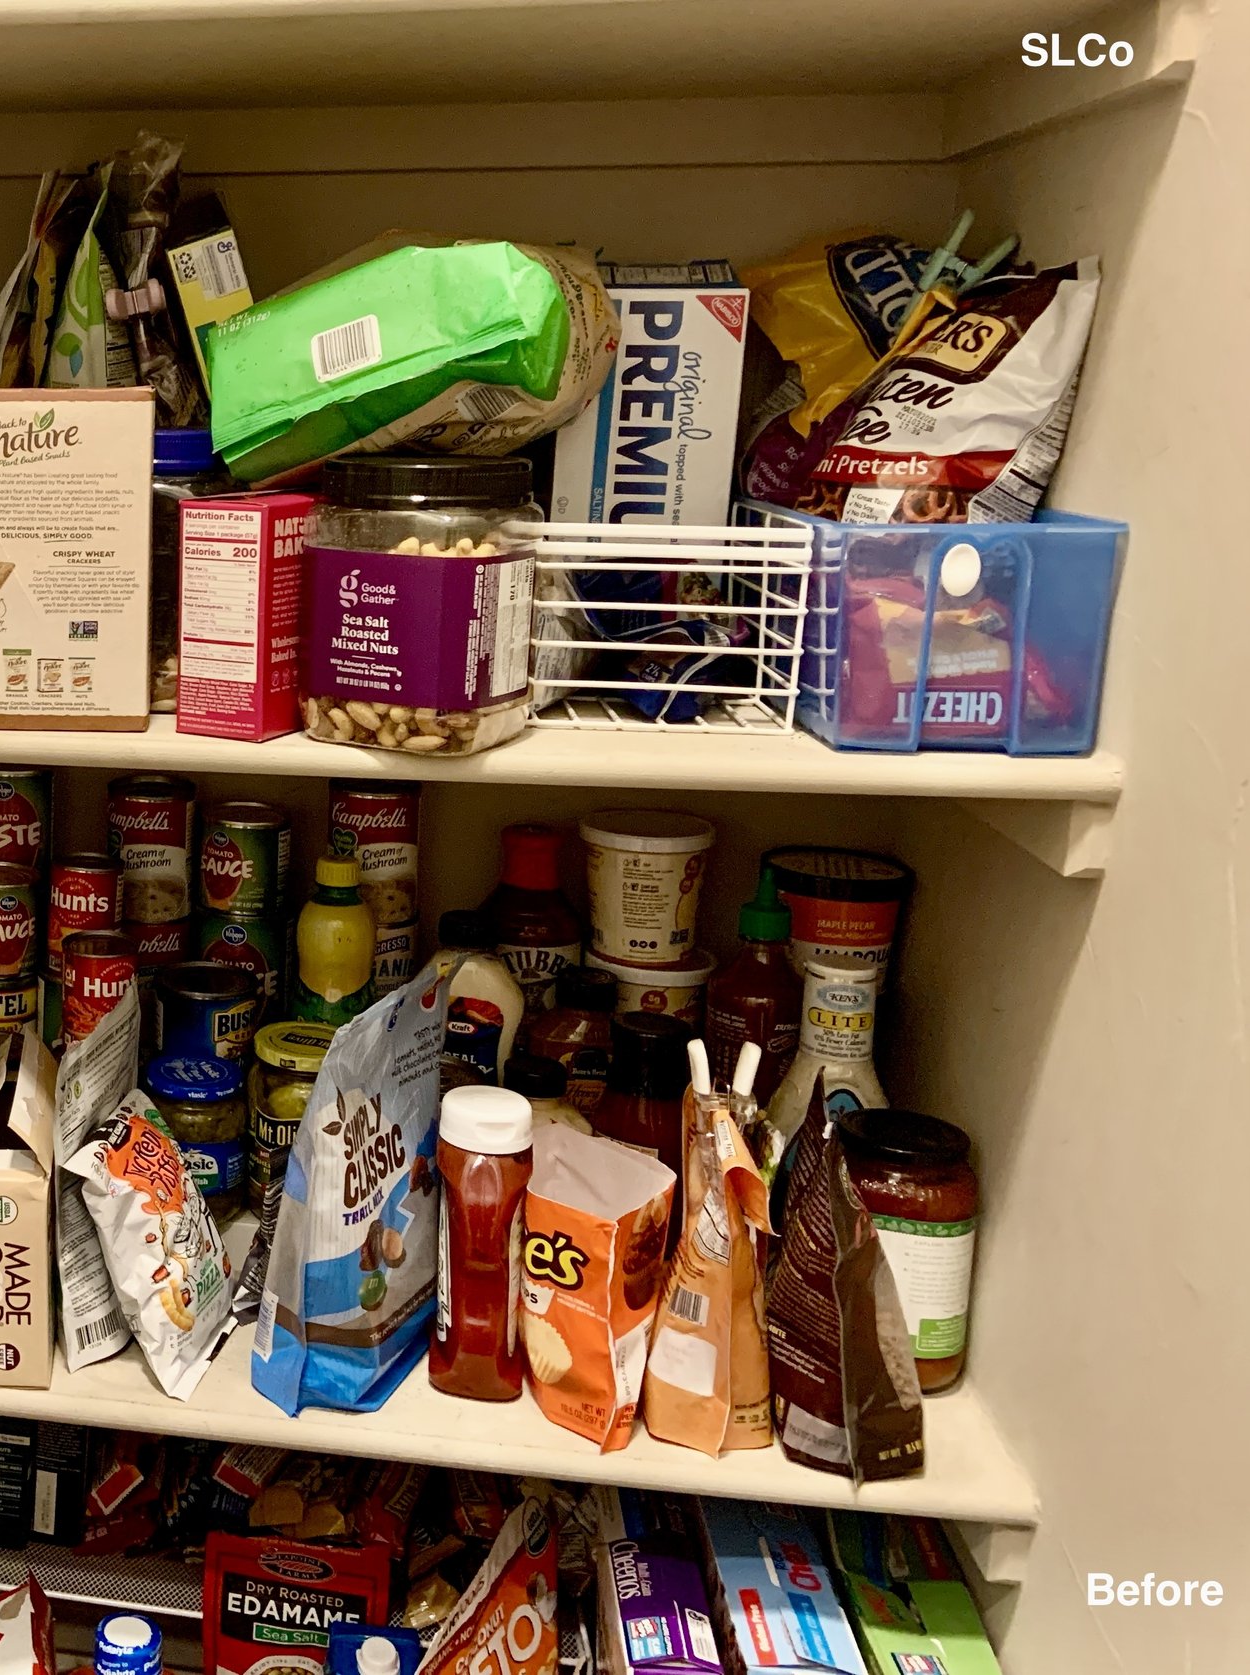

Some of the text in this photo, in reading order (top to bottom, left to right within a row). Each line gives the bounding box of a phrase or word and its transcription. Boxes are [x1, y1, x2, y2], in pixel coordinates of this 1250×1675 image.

[713, 297, 740, 327] NABISCO
[229, 323, 241, 334] OZ
[663, 351, 712, 440] original
[18, 417, 27, 426] to
[19, 453, 44, 465] Based
[45, 449, 71, 460] Snacks
[837, 455, 929, 476] Pretzels
[674, 443, 689, 504] topped with
[185, 511, 255, 522] Nutrition Facts
[0, 532, 42, 540] DELICIOUS,
[42, 532, 69, 540] SIMPLY
[69, 532, 94, 540] GOOD.
[185, 529, 245, 541] Serving package
[52, 550, 116, 559] CRISPY WHEAT
[184, 546, 257, 558] Calories 200
[360, 594, 396, 605] Gather
[342, 613, 389, 628] Sea Salt
[341, 625, 389, 642] Roasted
[331, 637, 399, 655] Mixed Nuts
[271, 649, 290, 664] Baked
[330, 657, 371, 669] With Almonds,
[337, 665, 391, 678] Hazelnuts Pecans
[331, 800, 407, 831] Campbell's
[126, 848, 159, 860] Cream
[362, 847, 397, 860] Cream
[200, 855, 254, 879] SAUCE
[817, 918, 847, 930] MAPLE
[450, 1022, 471, 1032] Kraft
[816, 1011, 868, 1028] LITE
[187, 1091, 208, 1099] vlasic
[258, 1116, 276, 1145] Mt.
[343, 1092, 382, 1161] SIMPLY
[343, 1123, 406, 1209] CLASSIC
[3, 1201, 11, 1219] USDA
[342, 1204, 373, 1227] TRAIL
[3, 1241, 32, 1326] MADE
[195, 1266, 222, 1303] PIZZA
[6, 1347, 14, 1366] NUT
[581, 1402, 607, 1418] NET WT
[609, 1540, 642, 1600] Cheerios
[245, 1580, 345, 1609] DRY ROASTED
[227, 1591, 361, 1628] EDAMAME
[261, 1625, 320, 1644] Sea Salt
